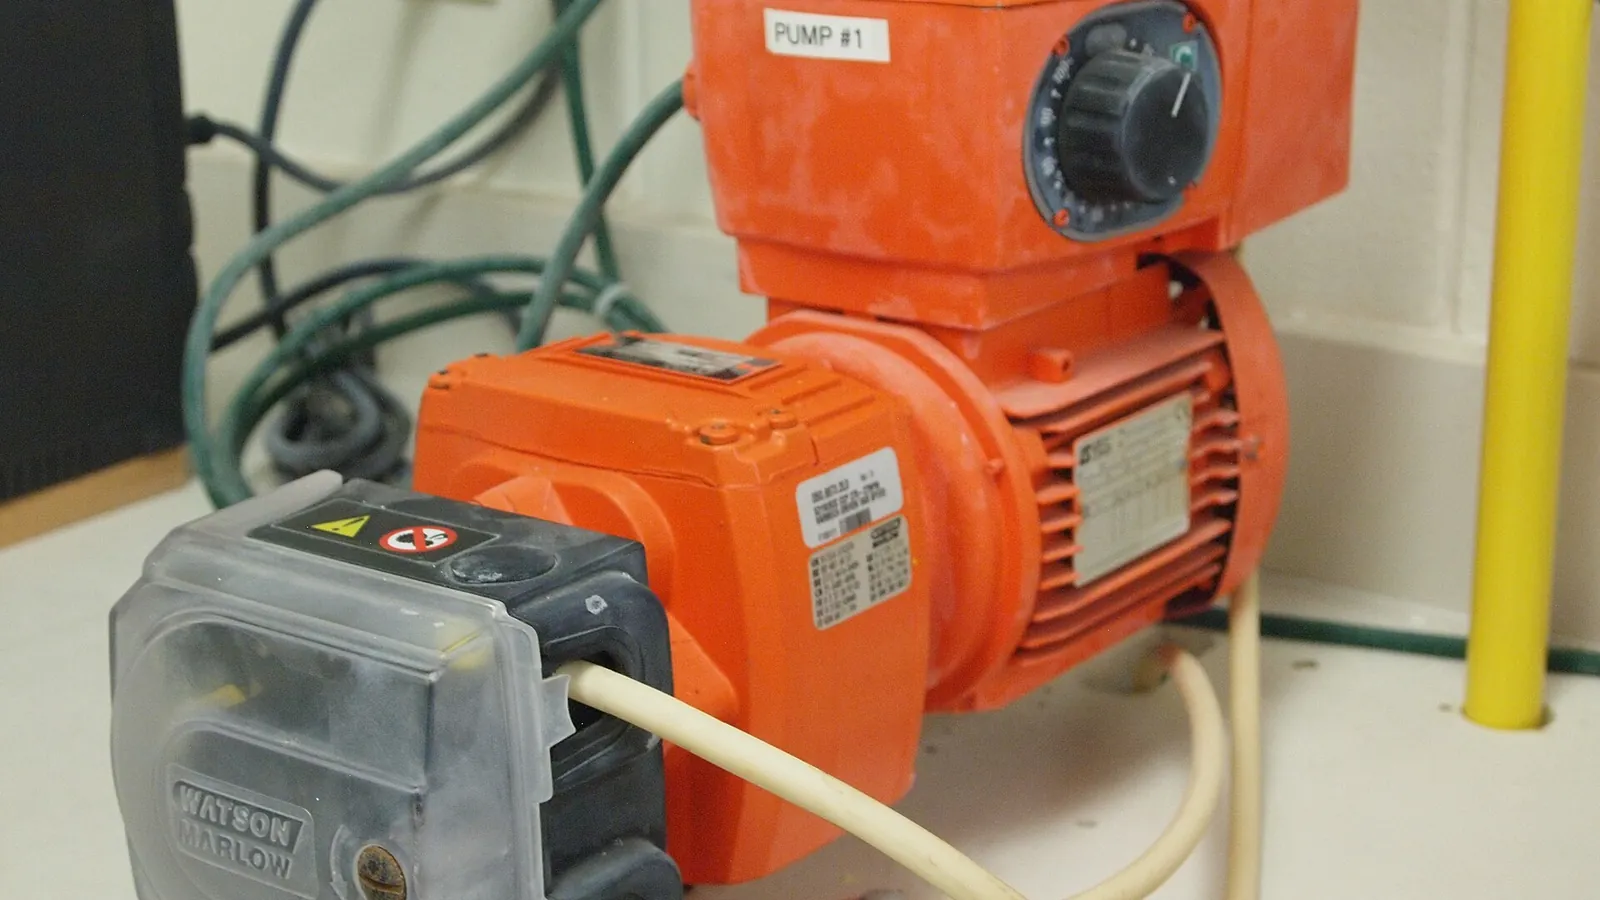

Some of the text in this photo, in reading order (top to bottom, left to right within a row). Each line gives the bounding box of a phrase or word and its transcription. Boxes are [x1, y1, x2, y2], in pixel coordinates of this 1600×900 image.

[774, 22, 862, 49] PUMP #1
[179, 785, 291, 847] WATSON
[179, 818, 291, 880] MARLOW
